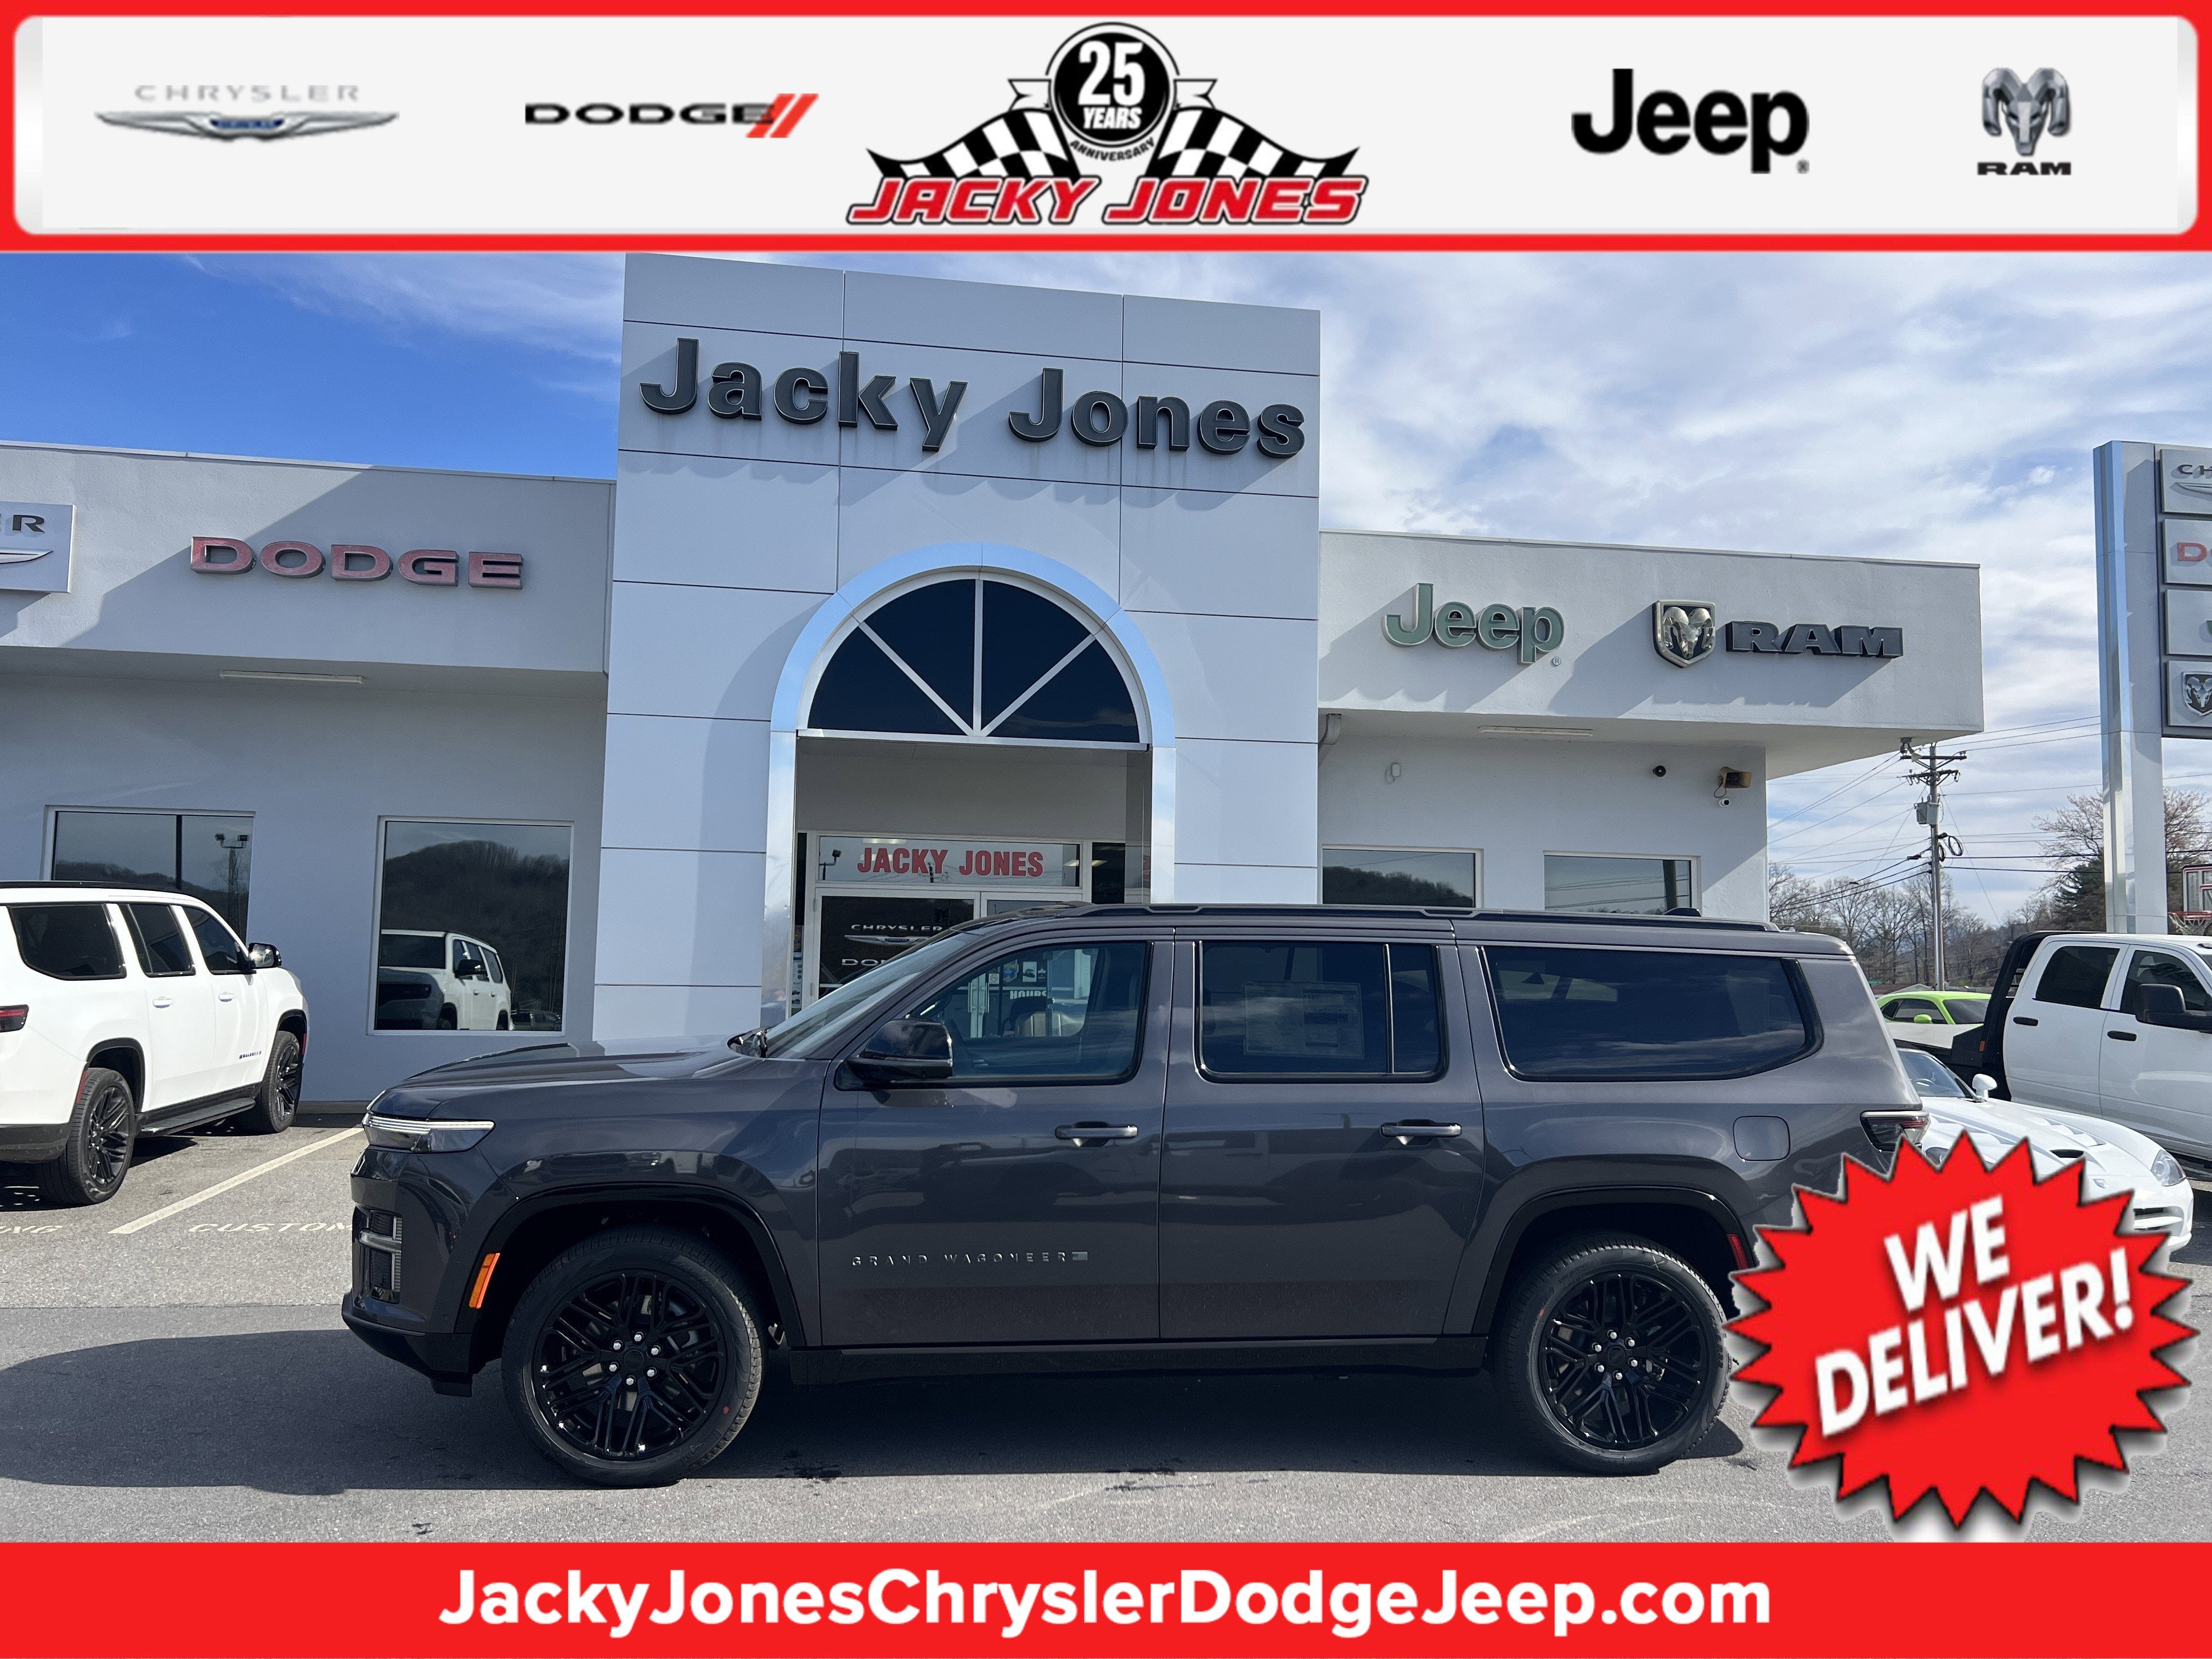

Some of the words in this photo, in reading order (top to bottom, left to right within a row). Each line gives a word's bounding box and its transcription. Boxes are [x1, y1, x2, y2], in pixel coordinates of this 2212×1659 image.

[639, 338, 968, 452] Jacky
[1008, 368, 1305, 460] Jones
[0, 514, 45, 533] R
[190, 535, 523, 590] DODGE
[2177, 542, 2212, 562] D
[1381, 583, 1565, 664] Jeep
[1726, 620, 1904, 659] RAM
[857, 848, 949, 874] JACKY
[958, 850, 1044, 877] JONES
[851, 1255, 928, 1267] GRAND
[944, 1251, 1066, 1265] WAGONEER
